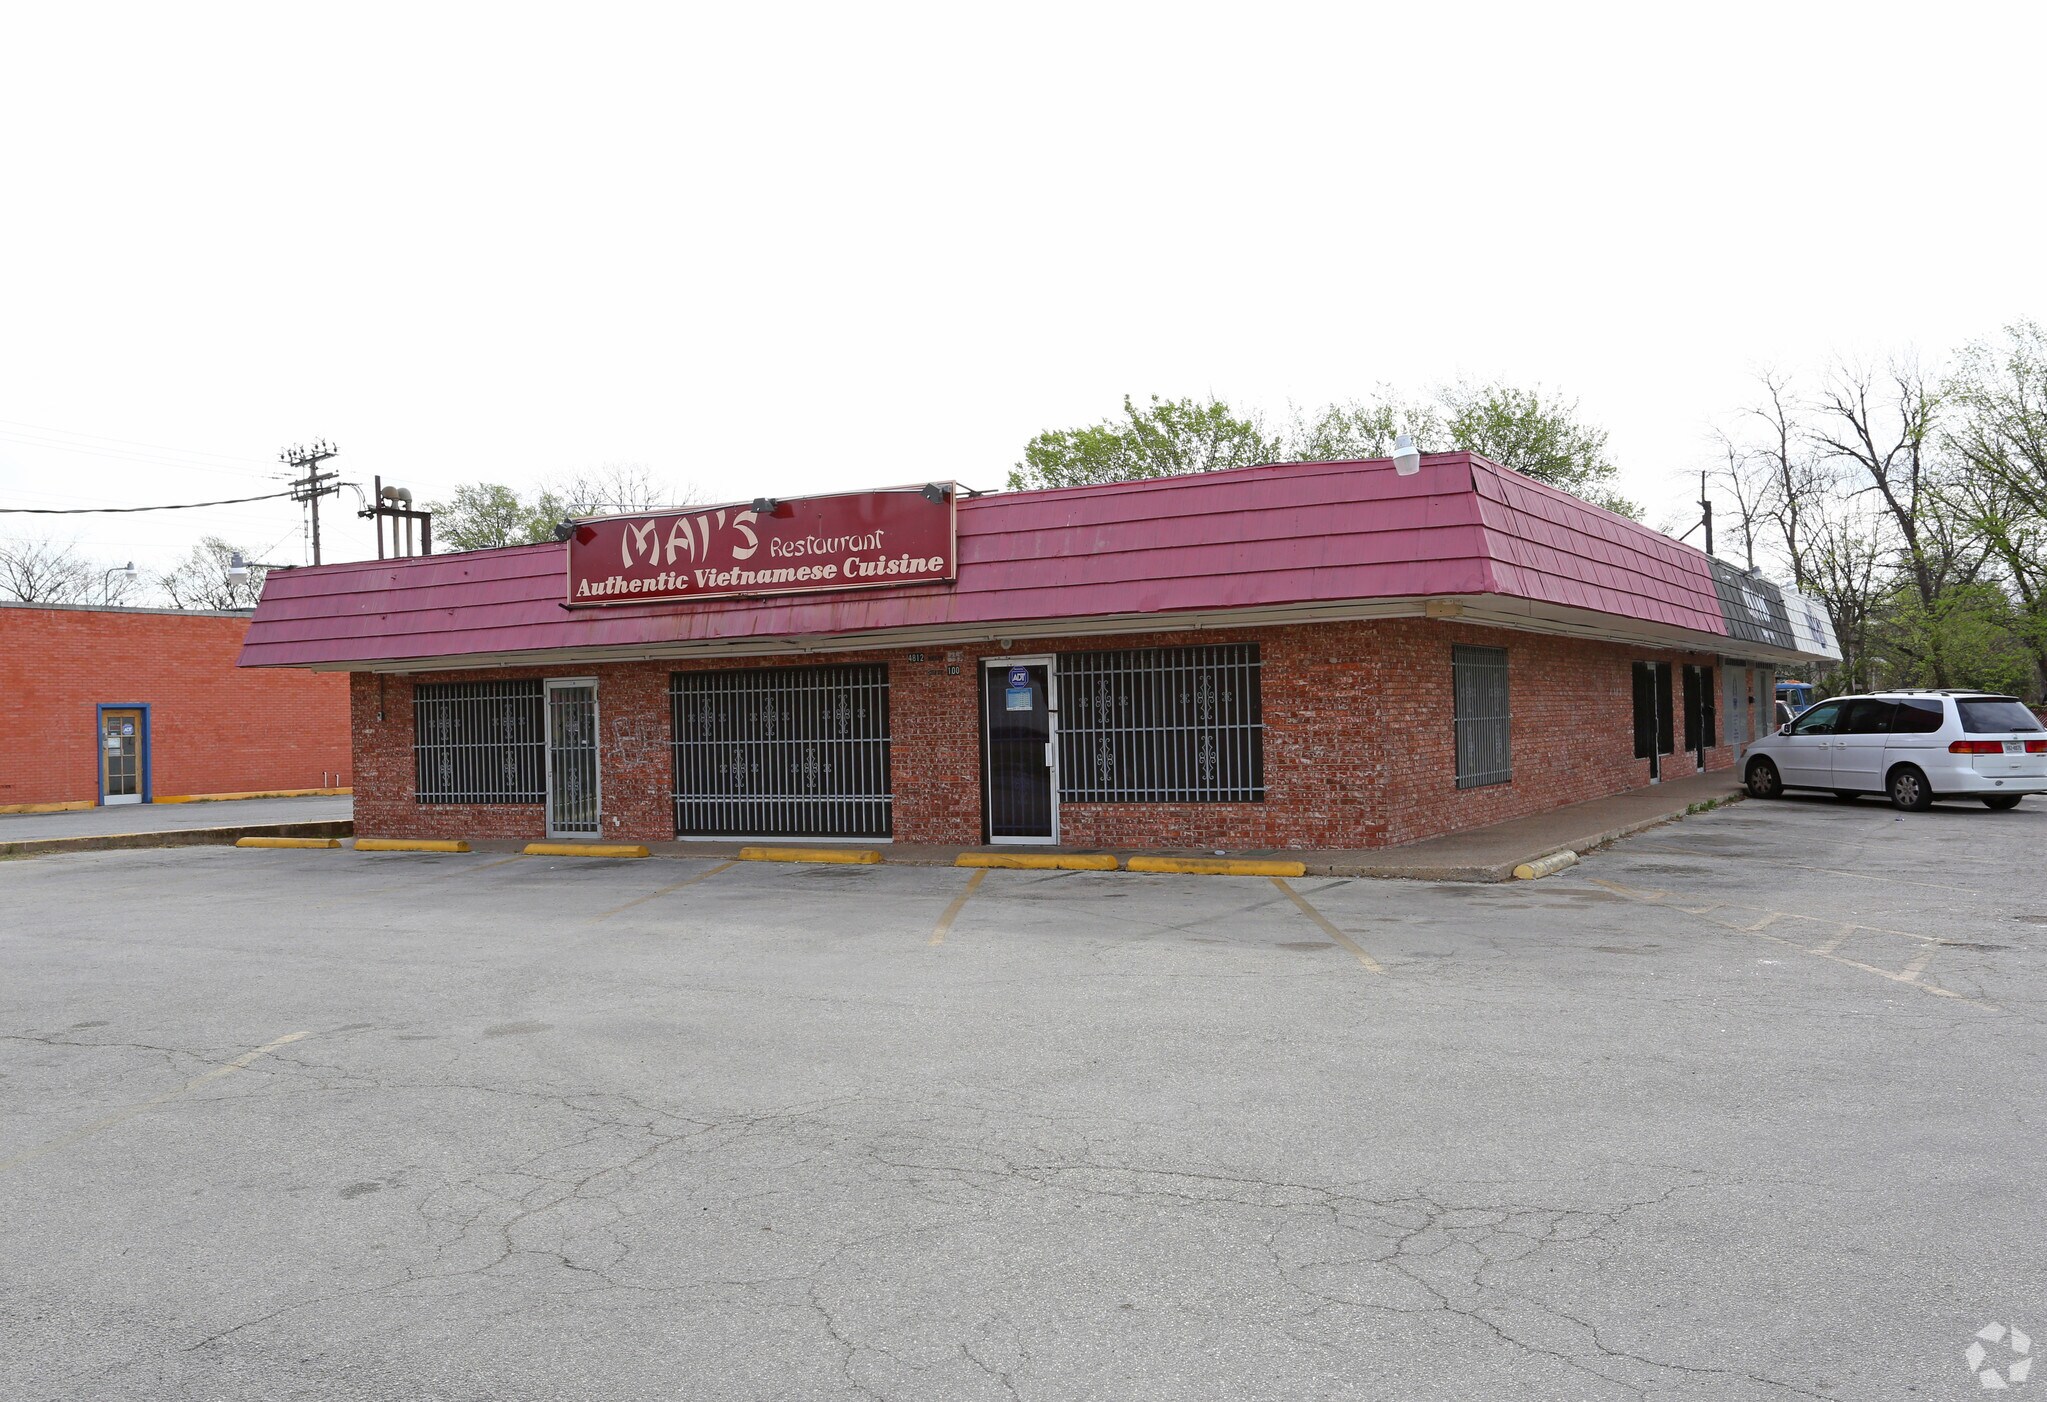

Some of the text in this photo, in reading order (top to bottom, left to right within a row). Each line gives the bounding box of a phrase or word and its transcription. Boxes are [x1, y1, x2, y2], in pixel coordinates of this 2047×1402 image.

[621, 510, 884, 569] MAI'S Restaurant
[576, 552, 944, 597] Authentic Vietnamese Cuisine
[908, 653, 924, 662] 4812
[948, 666, 960, 675] 100
[1012, 673, 1026, 682] ADT
